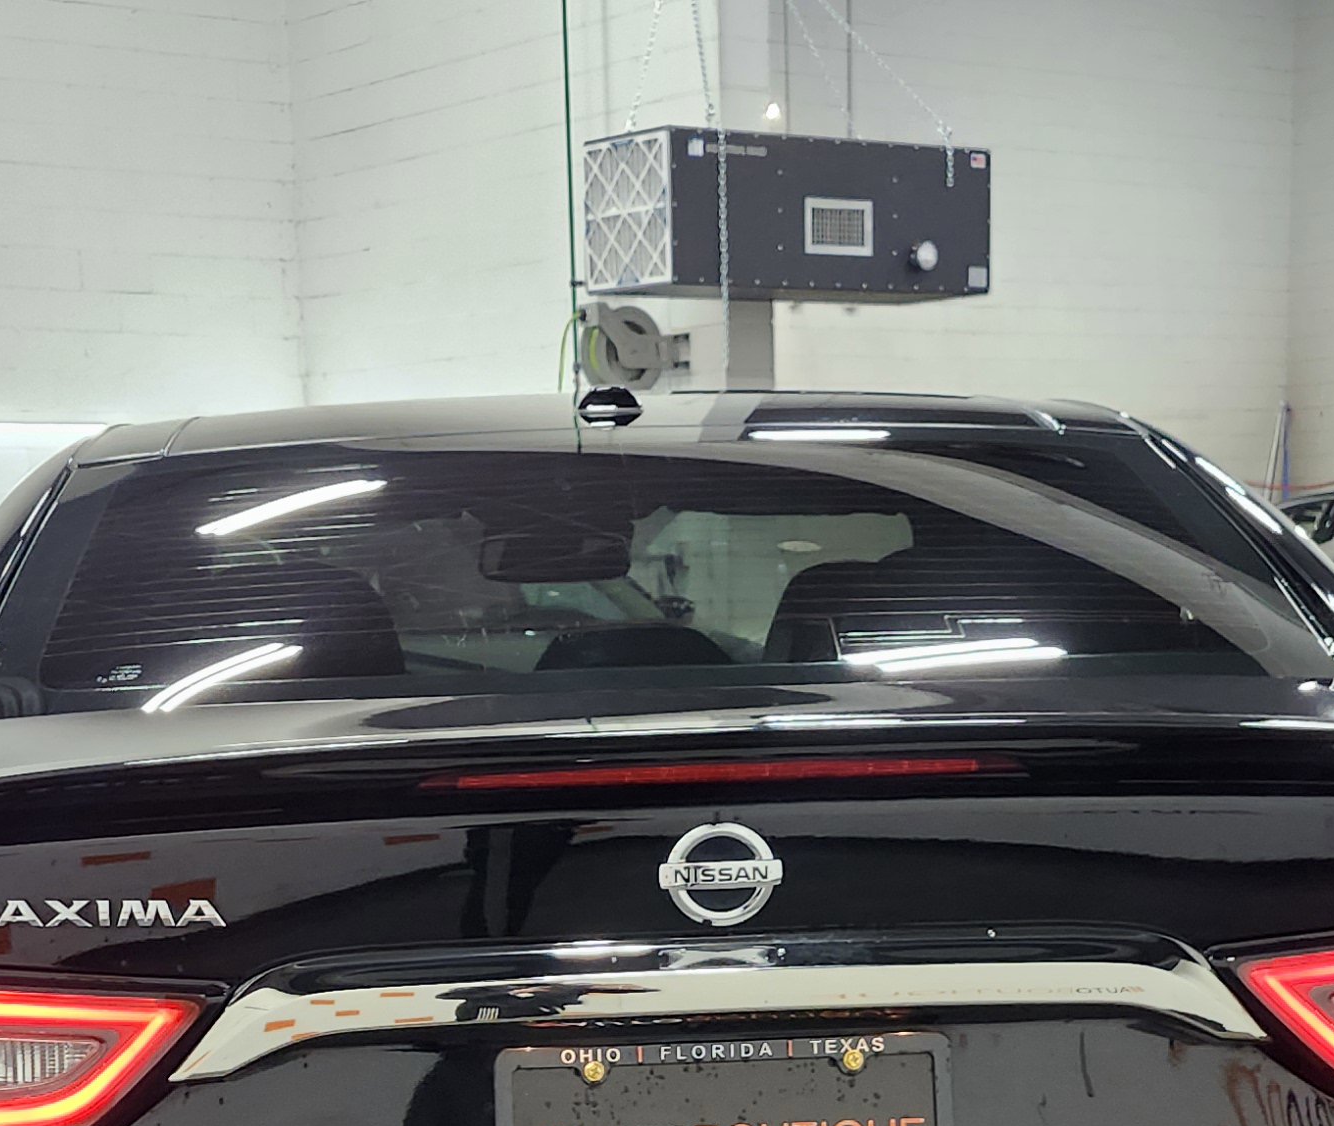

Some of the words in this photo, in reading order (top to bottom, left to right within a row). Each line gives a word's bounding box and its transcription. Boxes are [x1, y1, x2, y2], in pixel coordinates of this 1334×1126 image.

[674, 865, 769, 883] NISSAN
[560, 1048, 621, 1064] OHIO
[659, 1042, 774, 1061] FLORIDA
[809, 1037, 885, 1055] TEXAS
